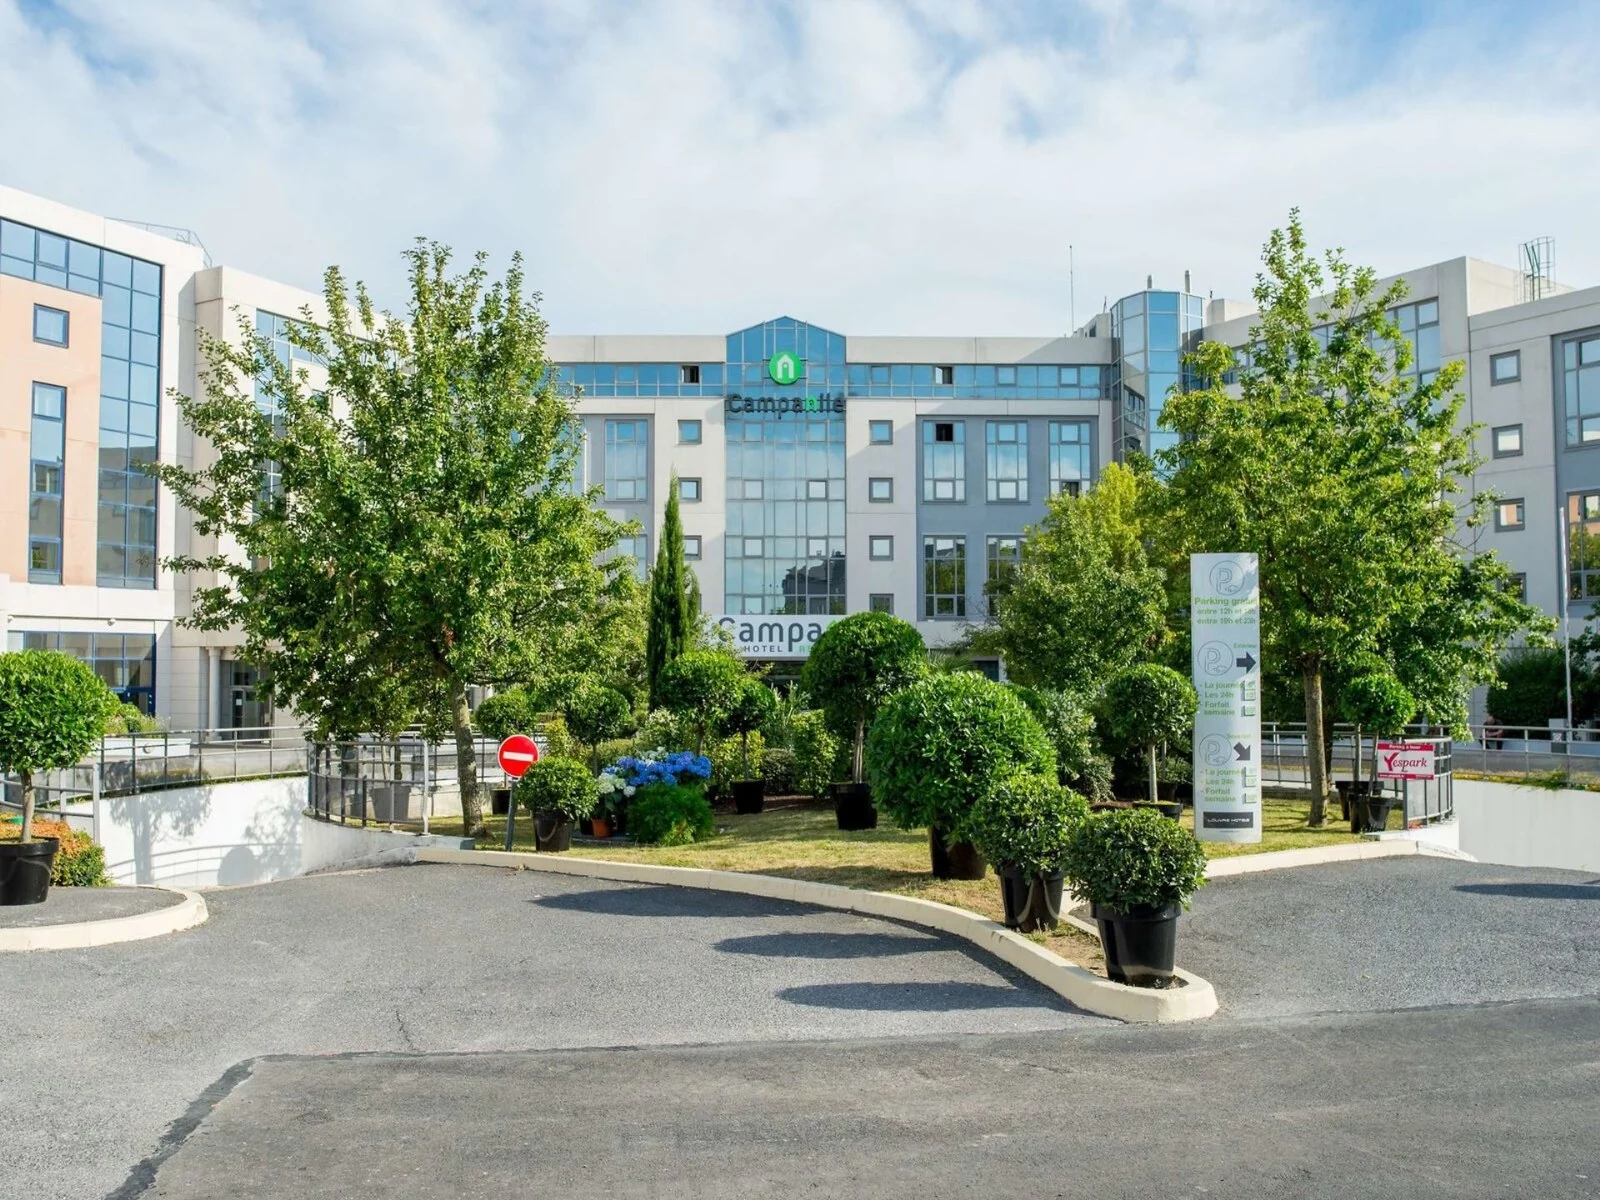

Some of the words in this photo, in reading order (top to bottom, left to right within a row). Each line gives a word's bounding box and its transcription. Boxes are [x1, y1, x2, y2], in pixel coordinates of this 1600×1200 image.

[728, 393, 846, 420] Campanile
[1195, 597, 1229, 606] Parking
[719, 617, 836, 652] Campa
[744, 645, 783, 653] HOTEL
[1204, 681, 1214, 689] La
[1204, 691, 1218, 699] Les
[1220, 691, 1234, 699] 24h
[1383, 752, 1427, 772] Yespark
